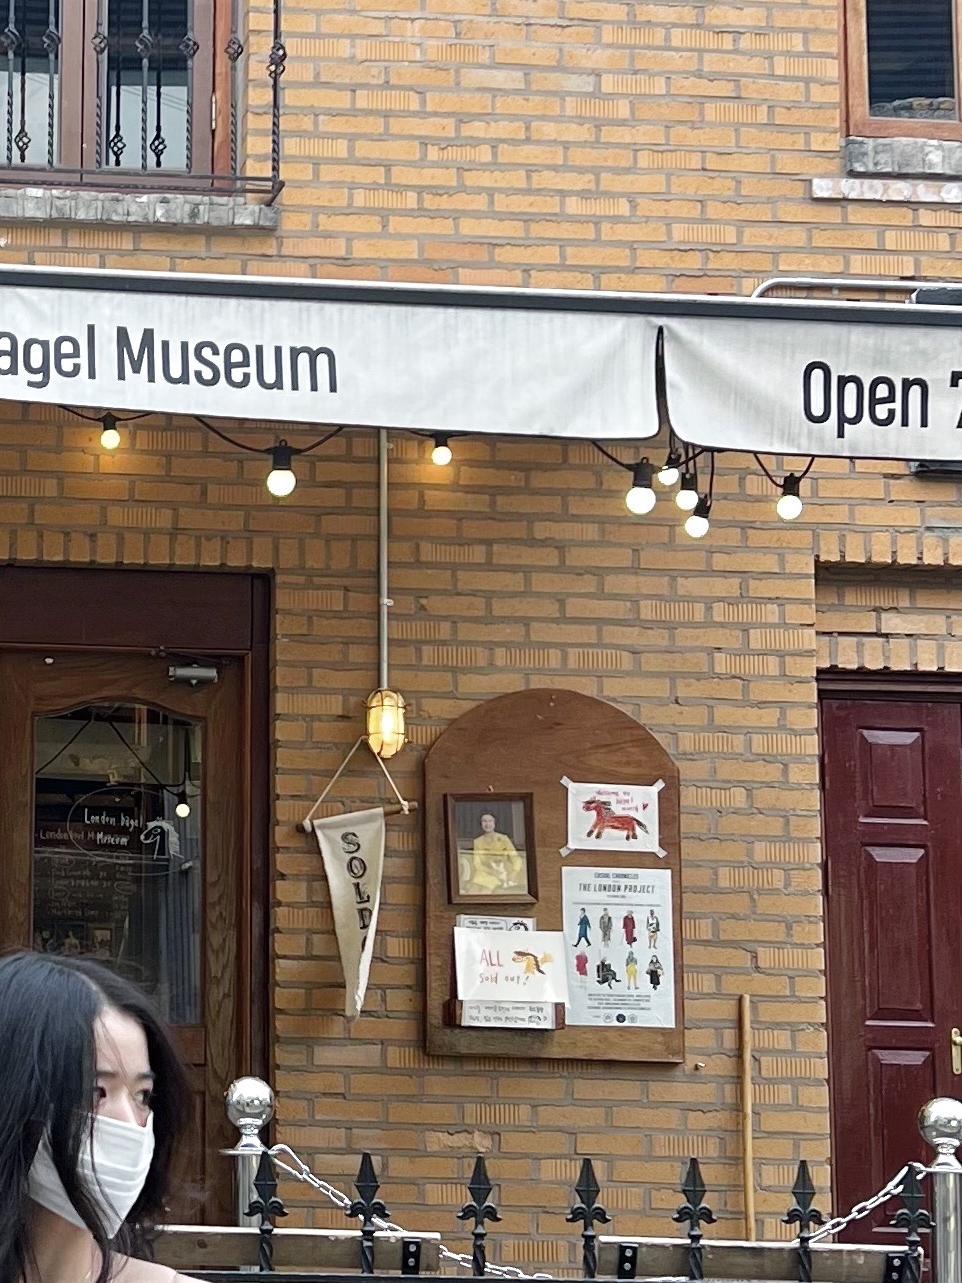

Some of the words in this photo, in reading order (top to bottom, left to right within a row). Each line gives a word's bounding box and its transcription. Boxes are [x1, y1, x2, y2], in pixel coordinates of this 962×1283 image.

[116, 325, 339, 394] Museum
[802, 360, 930, 439] Open
[340, 831, 373, 930] SOLD
[578, 882, 591, 892] THE
[593, 884, 621, 893] LONDON
[623, 885, 656, 894] PROJECT
[479, 972, 498, 985] Sold
[480, 948, 504, 967] ALL
